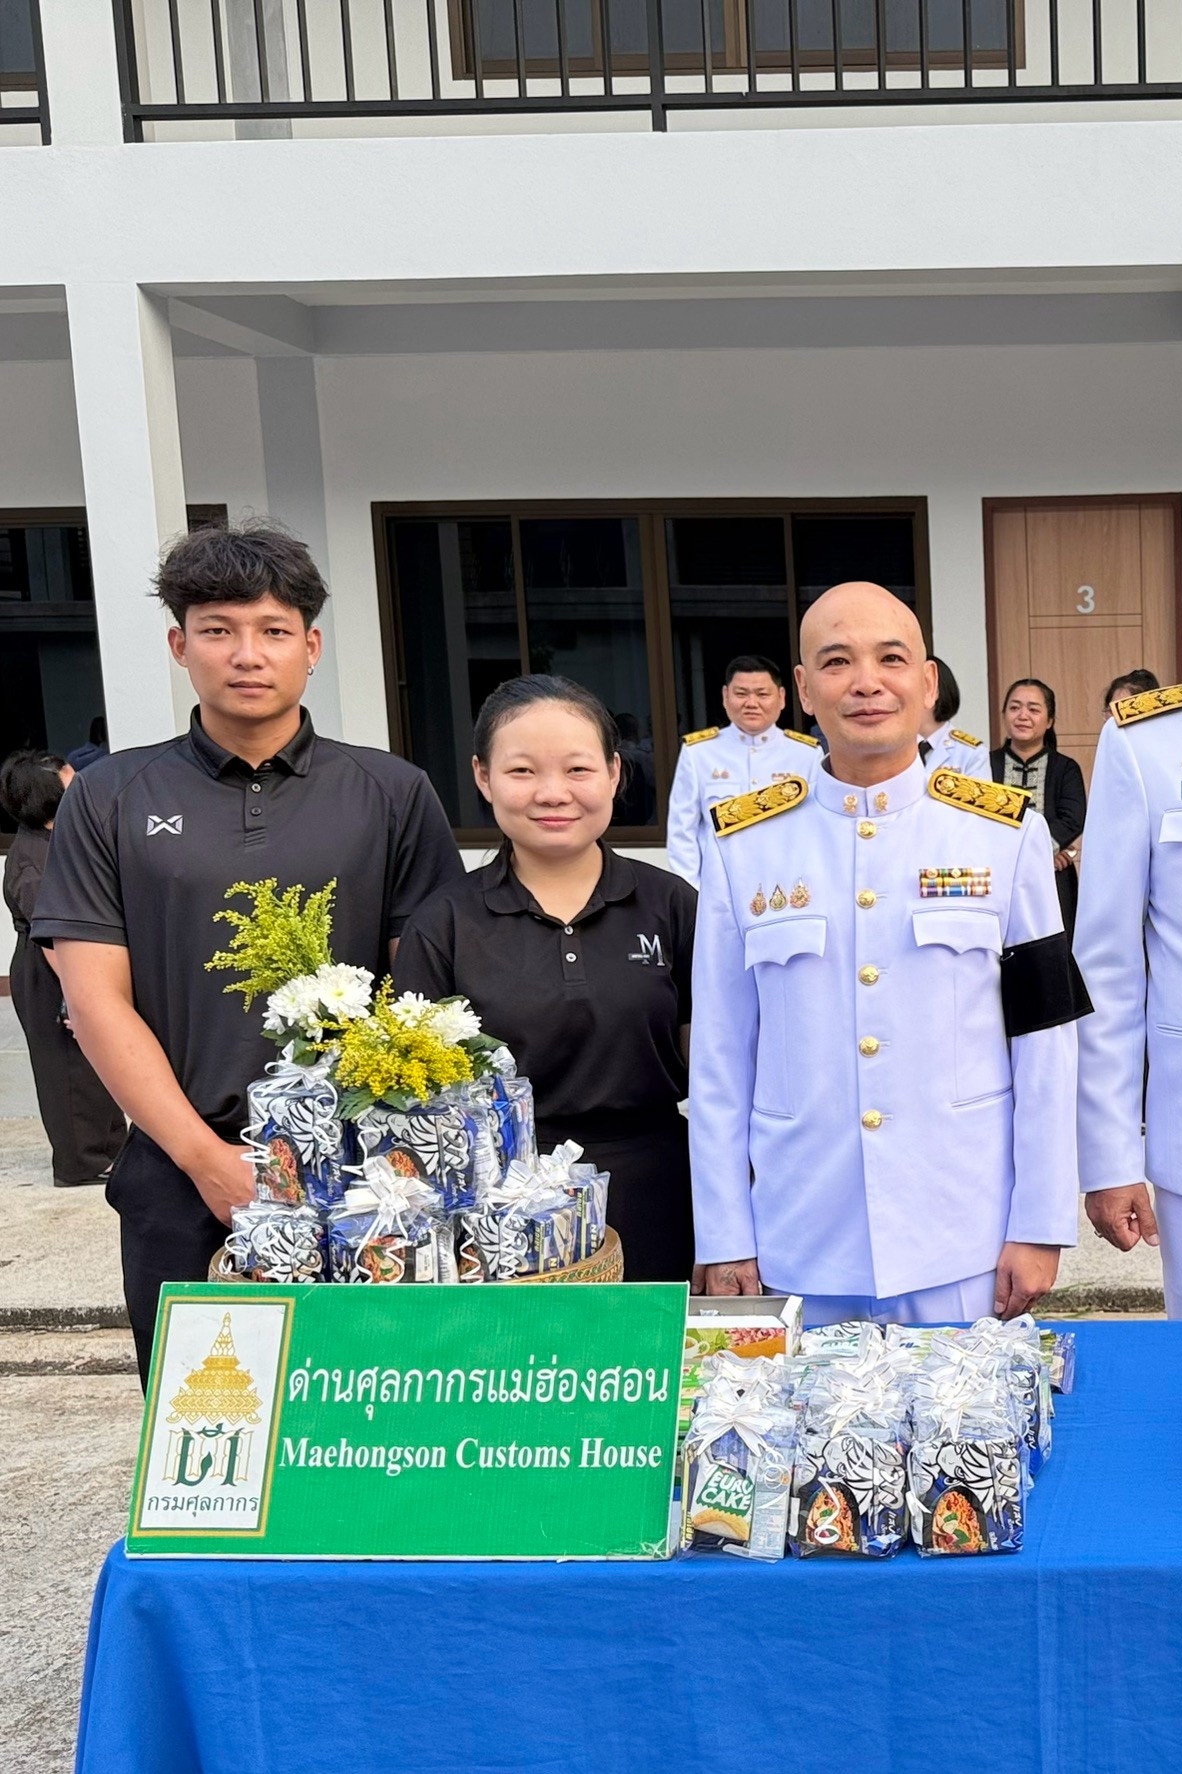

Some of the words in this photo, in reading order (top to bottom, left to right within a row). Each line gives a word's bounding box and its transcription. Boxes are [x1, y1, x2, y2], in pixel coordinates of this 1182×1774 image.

[1076, 585, 1095, 614] 3
[288, 1354, 668, 1420] ด่านศุลกากรแม่ฮ่องสอน
[279, 1437, 446, 1476] Maehongson
[456, 1437, 571, 1469] Customs
[578, 1437, 662, 1468] House
[147, 1495, 259, 1517] กรมศุลกากร
[701, 1488, 751, 1510] CAKE
